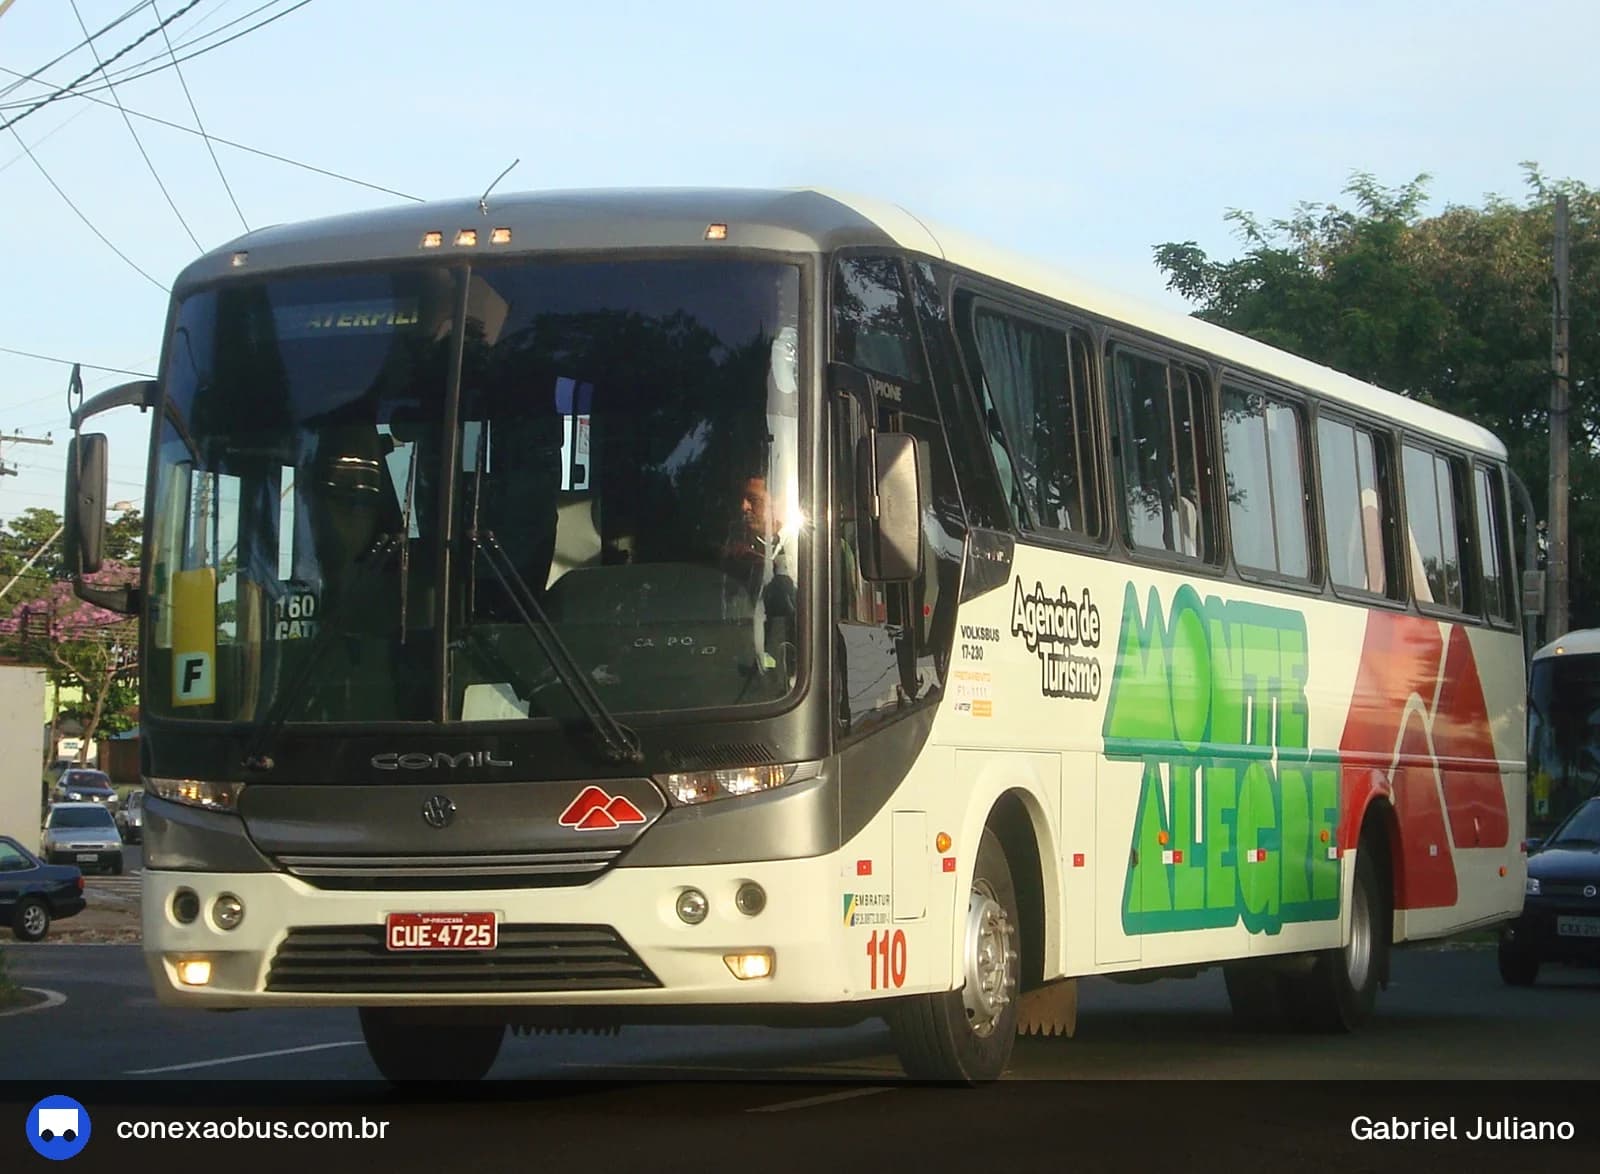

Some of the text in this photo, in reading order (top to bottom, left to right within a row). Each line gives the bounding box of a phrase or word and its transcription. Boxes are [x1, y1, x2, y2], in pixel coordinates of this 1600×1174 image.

[275, 595, 315, 618] 160
[1011, 574, 1101, 653] Agência de
[960, 625, 1000, 642] VOLKSBUS
[961, 644, 984, 661] 17-230
[182, 658, 204, 693] F
[1038, 640, 1101, 701] Turismo
[1102, 580, 1310, 757] MONTE
[371, 751, 513, 770] COMIL
[1121, 757, 1341, 935] ALEGRE
[855, 894, 891, 906] EMBRATUR
[391, 924, 492, 947] CUE-4725
[866, 928, 907, 990] 110
